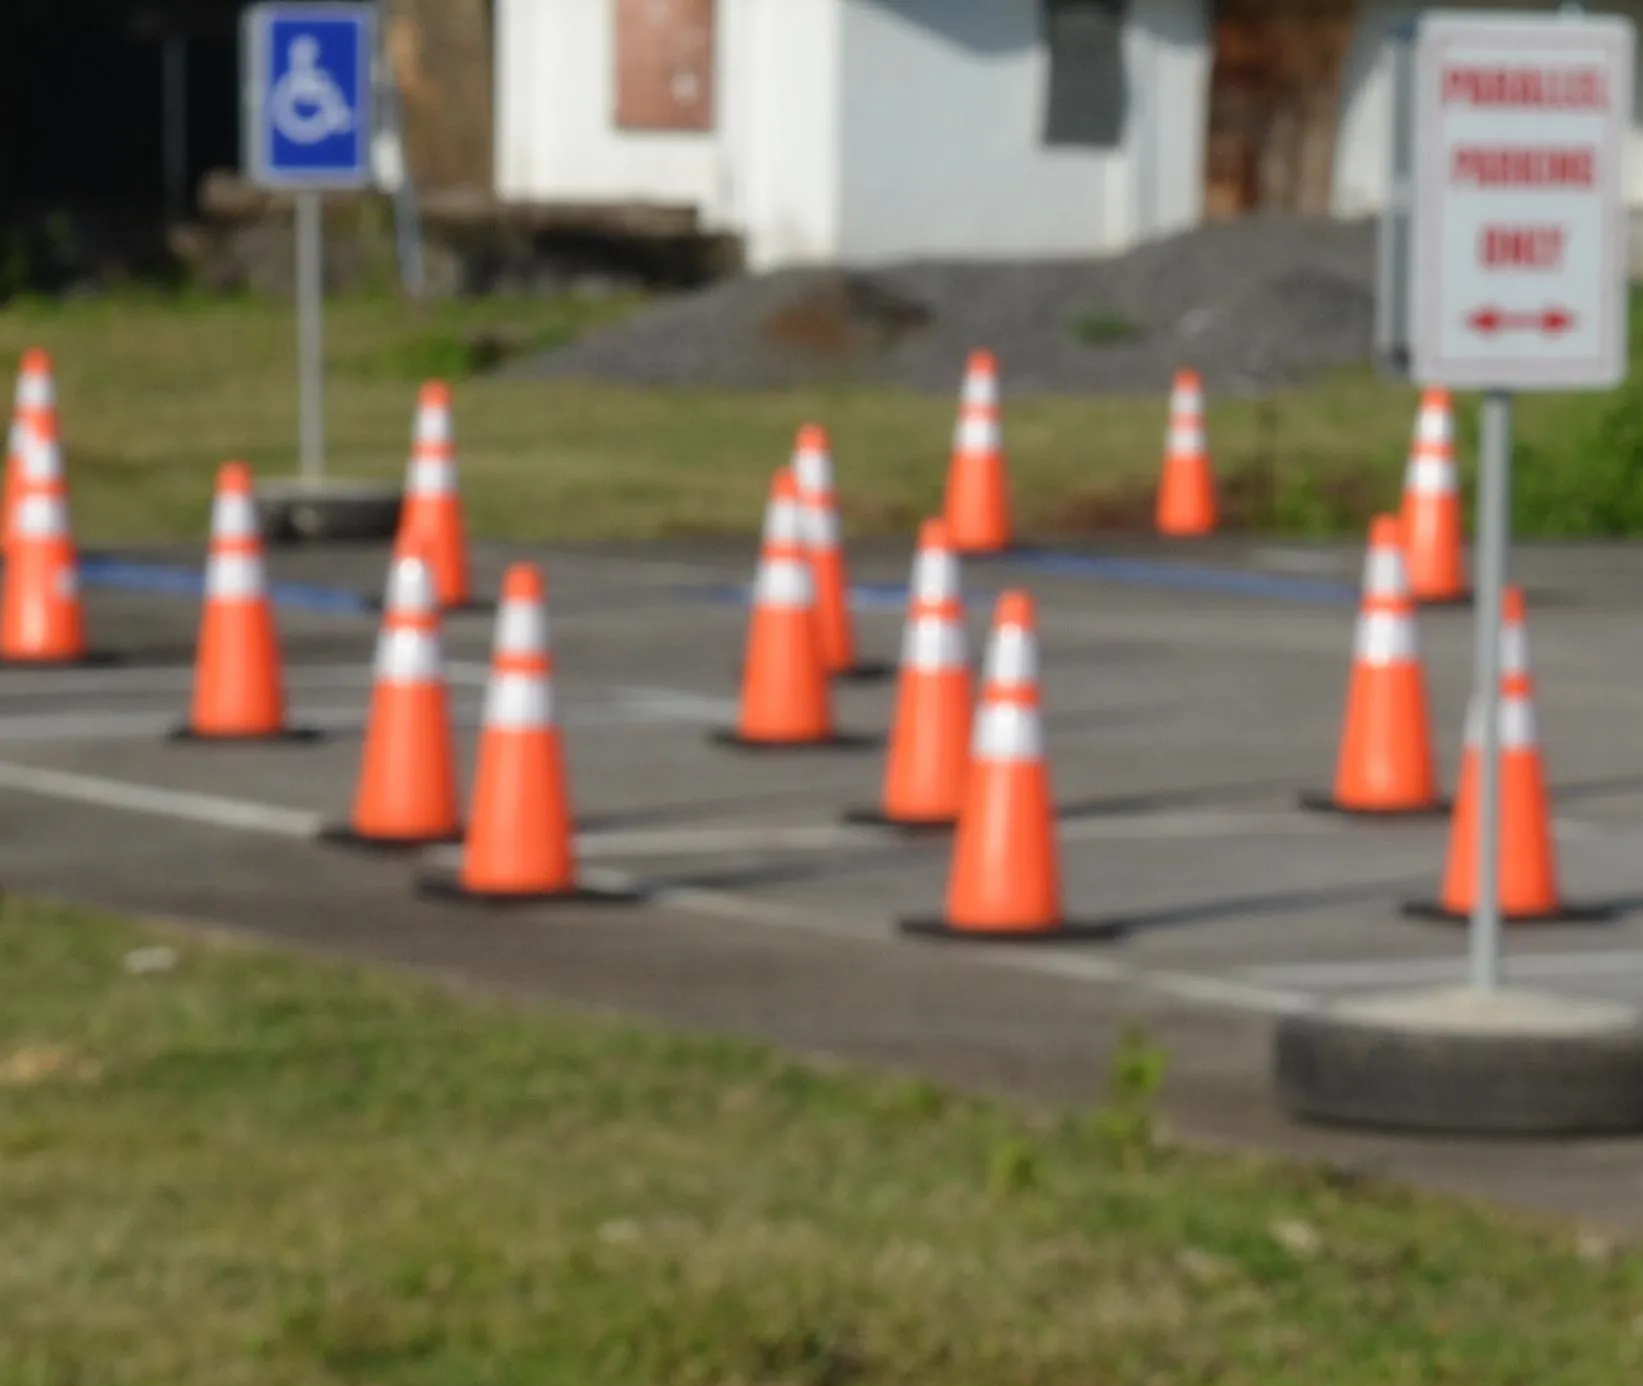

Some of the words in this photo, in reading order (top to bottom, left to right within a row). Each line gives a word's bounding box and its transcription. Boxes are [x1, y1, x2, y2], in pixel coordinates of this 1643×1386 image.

[1442, 65, 1608, 108] PARALLEL
[1453, 147, 1595, 187] PARKING
[1479, 225, 1566, 268] ONLY
